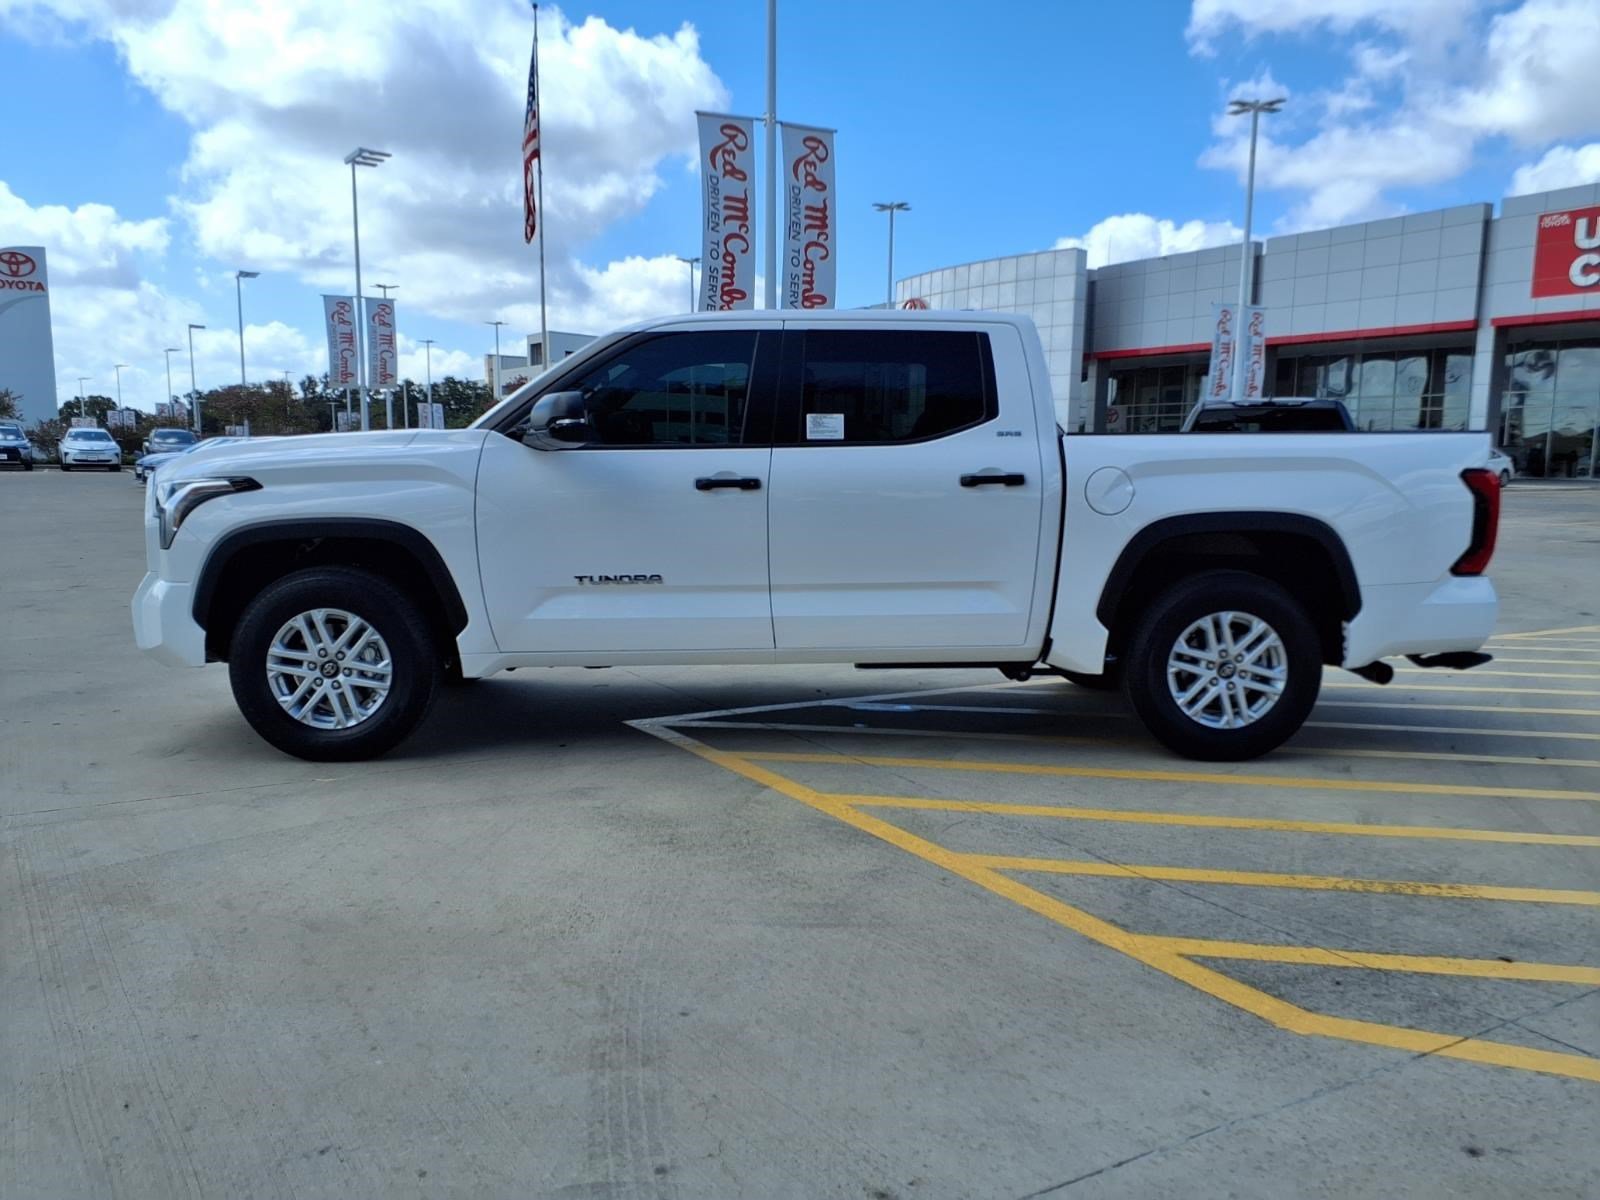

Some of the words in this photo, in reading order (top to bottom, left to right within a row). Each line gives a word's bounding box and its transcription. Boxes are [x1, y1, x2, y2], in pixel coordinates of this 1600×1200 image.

[710, 123, 748, 182] Red
[793, 136, 828, 192] Red
[709, 175, 720, 233] DRIVEN
[790, 185, 801, 242] DRIVEN
[1574, 215, 1600, 250] U
[710, 240, 720, 261] TO
[790, 248, 800, 268] TO
[801, 197, 829, 309] McComb
[0, 279, 45, 291] OYOTA
[1568, 253, 1600, 287] C
[706, 266, 719, 311] SERVE
[789, 273, 800, 309] SERV
[331, 301, 352, 326] Red
[372, 303, 393, 329] Red
[574, 574, 664, 585] TUNDRA
